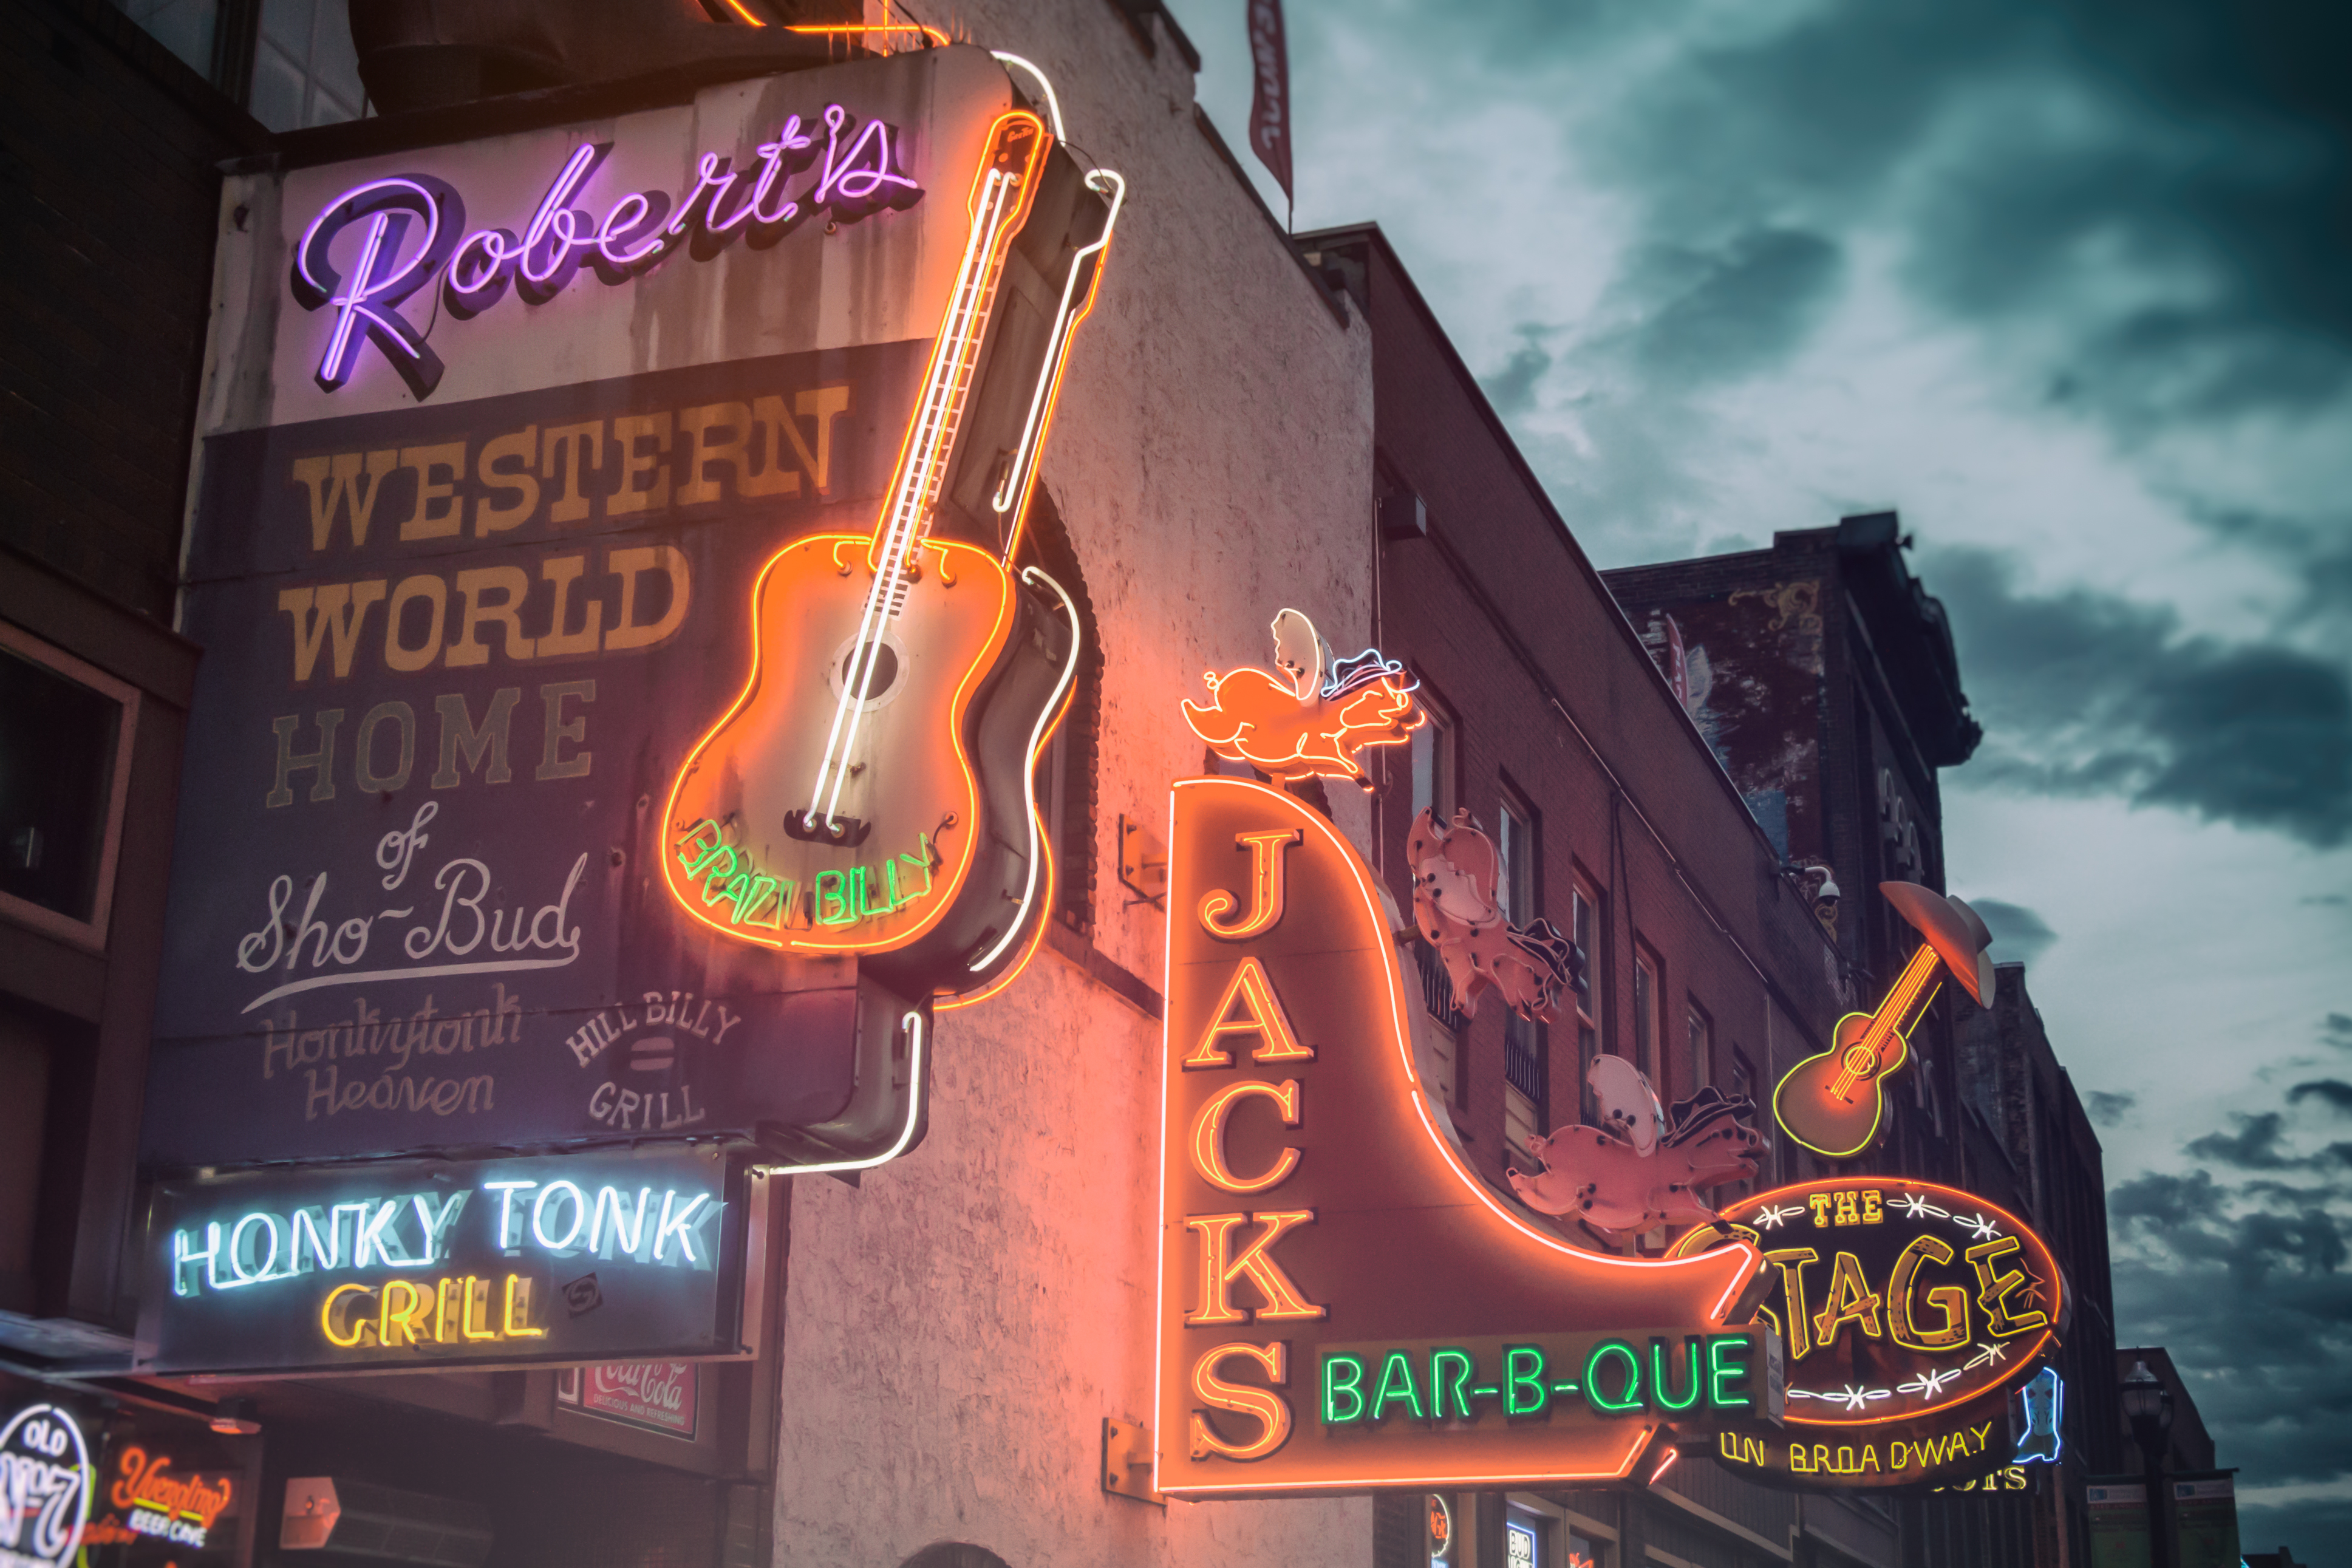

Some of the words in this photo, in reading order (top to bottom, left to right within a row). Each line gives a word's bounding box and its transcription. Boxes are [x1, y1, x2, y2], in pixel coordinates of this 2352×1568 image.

[291, 104, 925, 400] Robert's
[292, 385, 850, 551] WESTERN
[278, 545, 691, 681] WORLD
[266, 680, 596, 808] HOME
[376, 800, 438, 890] of
[815, 832, 932, 925] BILLY
[566, 1001, 638, 1069] HILL
[643, 990, 742, 1045] BILLY
[304, 1064, 494, 1121] Heaven
[589, 1081, 706, 1131] GRILL
[1181, 828, 1328, 1461] JACKS
[172, 1190, 468, 1297] HONKY
[483, 1178, 724, 1269] TONK
[1808, 1190, 1883, 1227] THE
[321, 1273, 547, 1348] GRILL
[593, 1393, 629, 1411] DELICIOUS
[630, 1403, 646, 1416] AND
[646, 1407, 685, 1427] REFRESHING
[1321, 1334, 1755, 1425] BAR-B-QUE
[23, 1419, 68, 1457] OLD
[1720, 1432, 1765, 1466] ON
[1509, 1529, 1530, 1560] BUD
